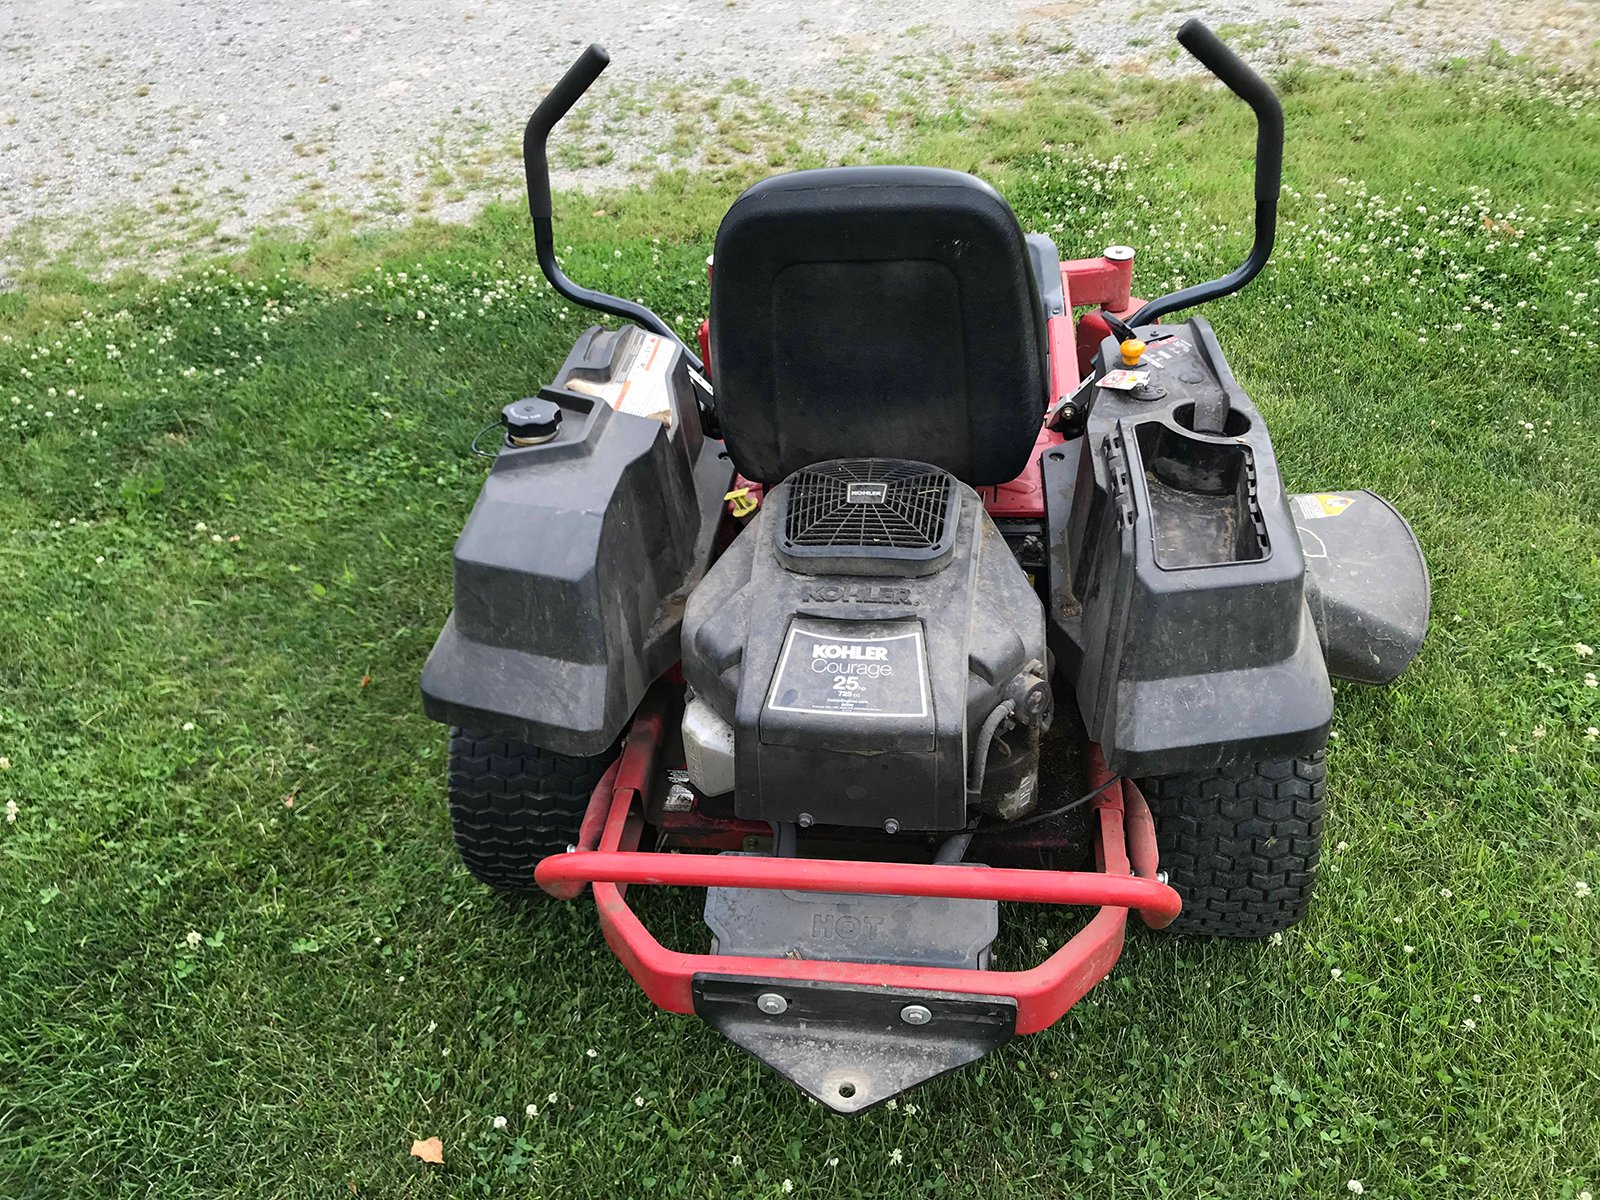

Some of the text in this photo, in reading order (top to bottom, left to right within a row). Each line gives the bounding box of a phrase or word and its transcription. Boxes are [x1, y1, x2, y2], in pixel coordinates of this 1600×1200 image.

[802, 585, 914, 605] KOHLER
[812, 644, 888, 661] KOHLER
[811, 658, 892, 679] Courage
[811, 914, 884, 940] HOT
